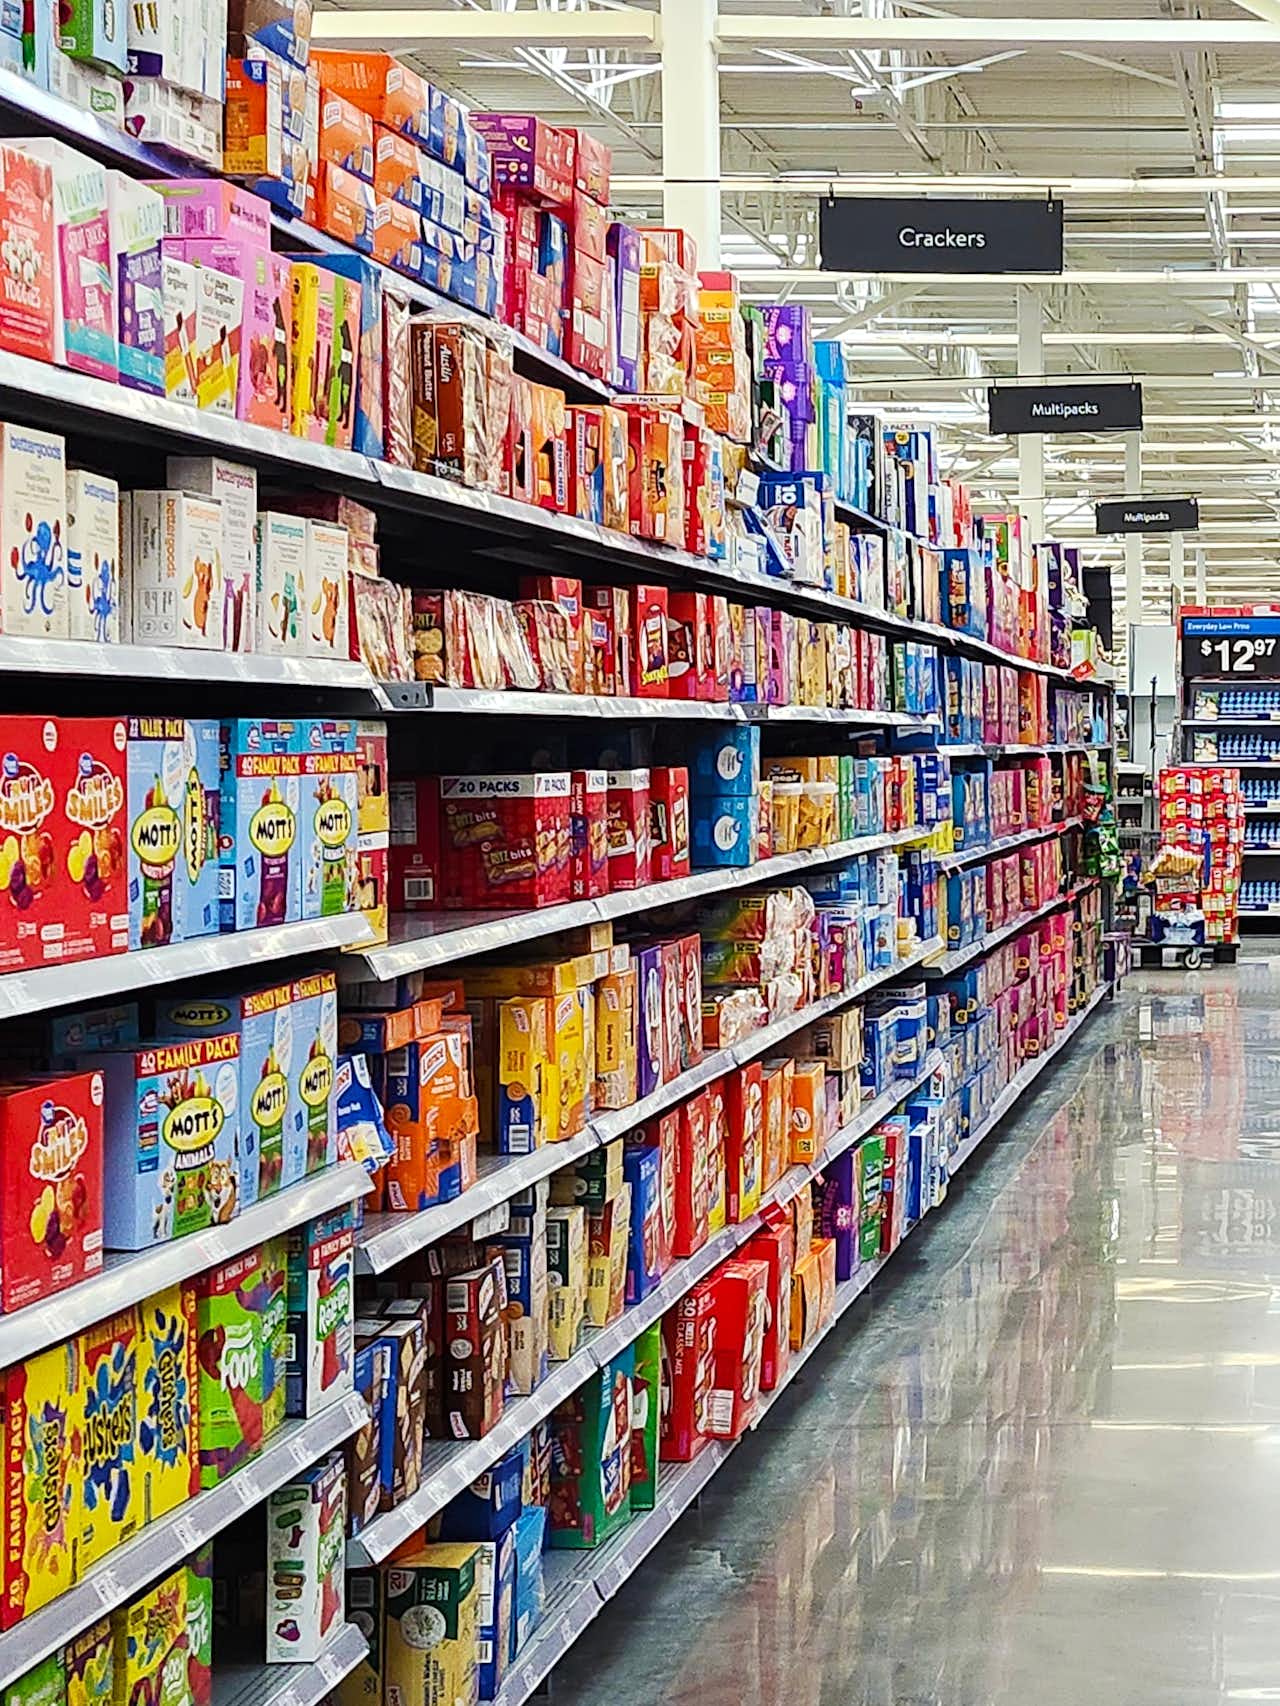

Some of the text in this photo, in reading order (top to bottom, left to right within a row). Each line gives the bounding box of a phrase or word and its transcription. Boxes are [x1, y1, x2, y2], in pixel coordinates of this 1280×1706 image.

[899, 228, 986, 248] Crackers
[423, 330, 432, 401] Peanut Butter
[440, 344, 452, 382] Austin
[1032, 402, 1099, 418] Multipacks
[1123, 511, 1170, 523] Multipacks
[1187, 623, 1218, 631] Everyday
[140, 720, 162, 737] VALUE
[164, 720, 183, 737] PACK
[253, 755, 300, 775] FAMILY PACK
[315, 754, 356, 772] FAMILY PACK
[459, 781, 519, 793] 20 PACKS
[0, 781, 53, 824] MILES
[67, 779, 123, 825] SMILES
[474, 811, 497, 821] bits
[490, 848, 532, 865] RITZ bits
[157, 1045, 202, 1072] FAMILY
[206, 1037, 238, 1061] PACK
[176, 1144, 214, 1168] ANIMALS
[684, 1298, 696, 1321] 30
[674, 1322, 685, 1358] CLASSIC
[11, 1399, 22, 1465] PACK
[85, 1392, 132, 1471] ushers
[42, 1421, 60, 1533] Gushers
[10, 1471, 21, 1562] FAMILY
